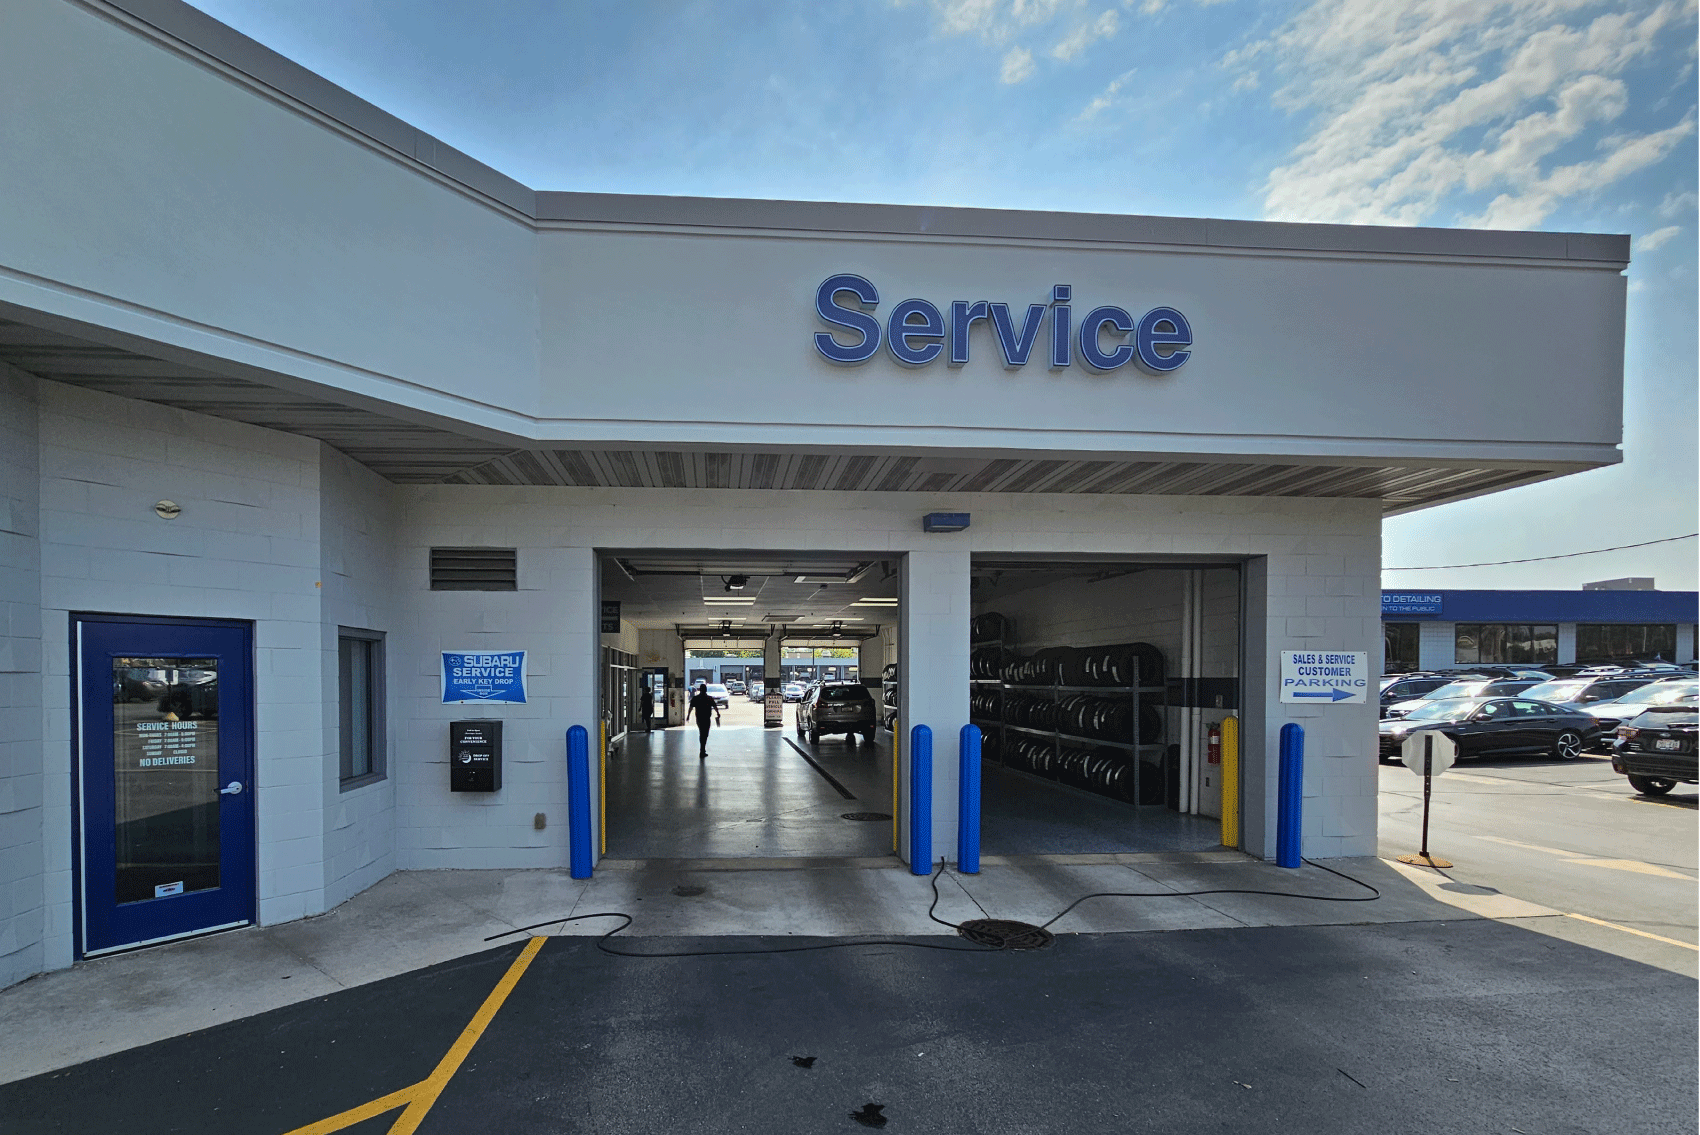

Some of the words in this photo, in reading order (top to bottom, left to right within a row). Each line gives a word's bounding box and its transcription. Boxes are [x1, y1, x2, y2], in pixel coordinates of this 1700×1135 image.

[814, 273, 1193, 374] Service
[464, 656, 519, 667] SUBARU
[1293, 654, 1316, 664] SALES
[1318, 655, 1324, 664] &
[1325, 655, 1355, 664] SERVICE
[453, 668, 514, 677] SERVICE
[1298, 667, 1352, 677] CUSTOMER
[1284, 679, 1367, 687] PARKING
[137, 722, 169, 731] SERVICE
[172, 721, 198, 730] HOURS
[139, 758, 151, 767] NO
[152, 756, 196, 766] DELIVERIES
